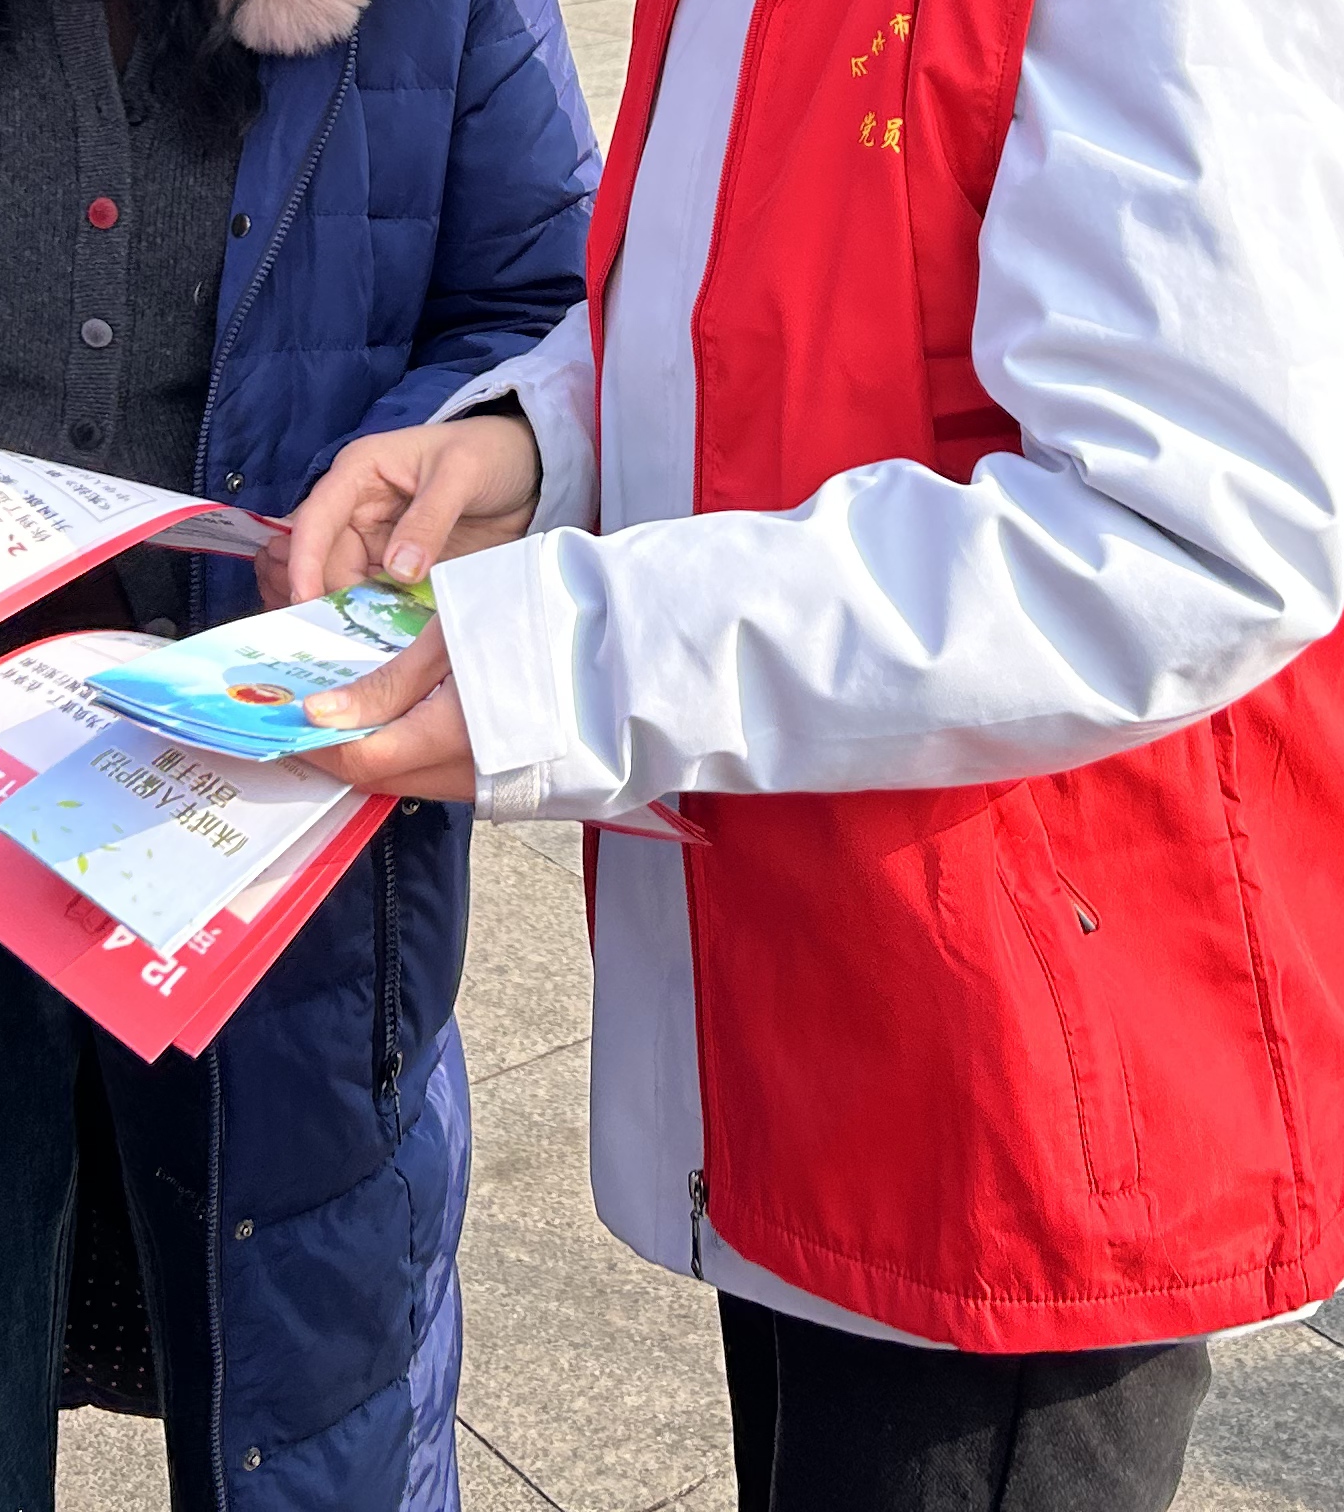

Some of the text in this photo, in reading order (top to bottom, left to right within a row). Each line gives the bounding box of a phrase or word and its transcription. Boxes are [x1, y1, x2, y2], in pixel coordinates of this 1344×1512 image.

[90, 748, 250, 858] 《未成年人保护法》
[152, 747, 242, 810] 宣传手册
